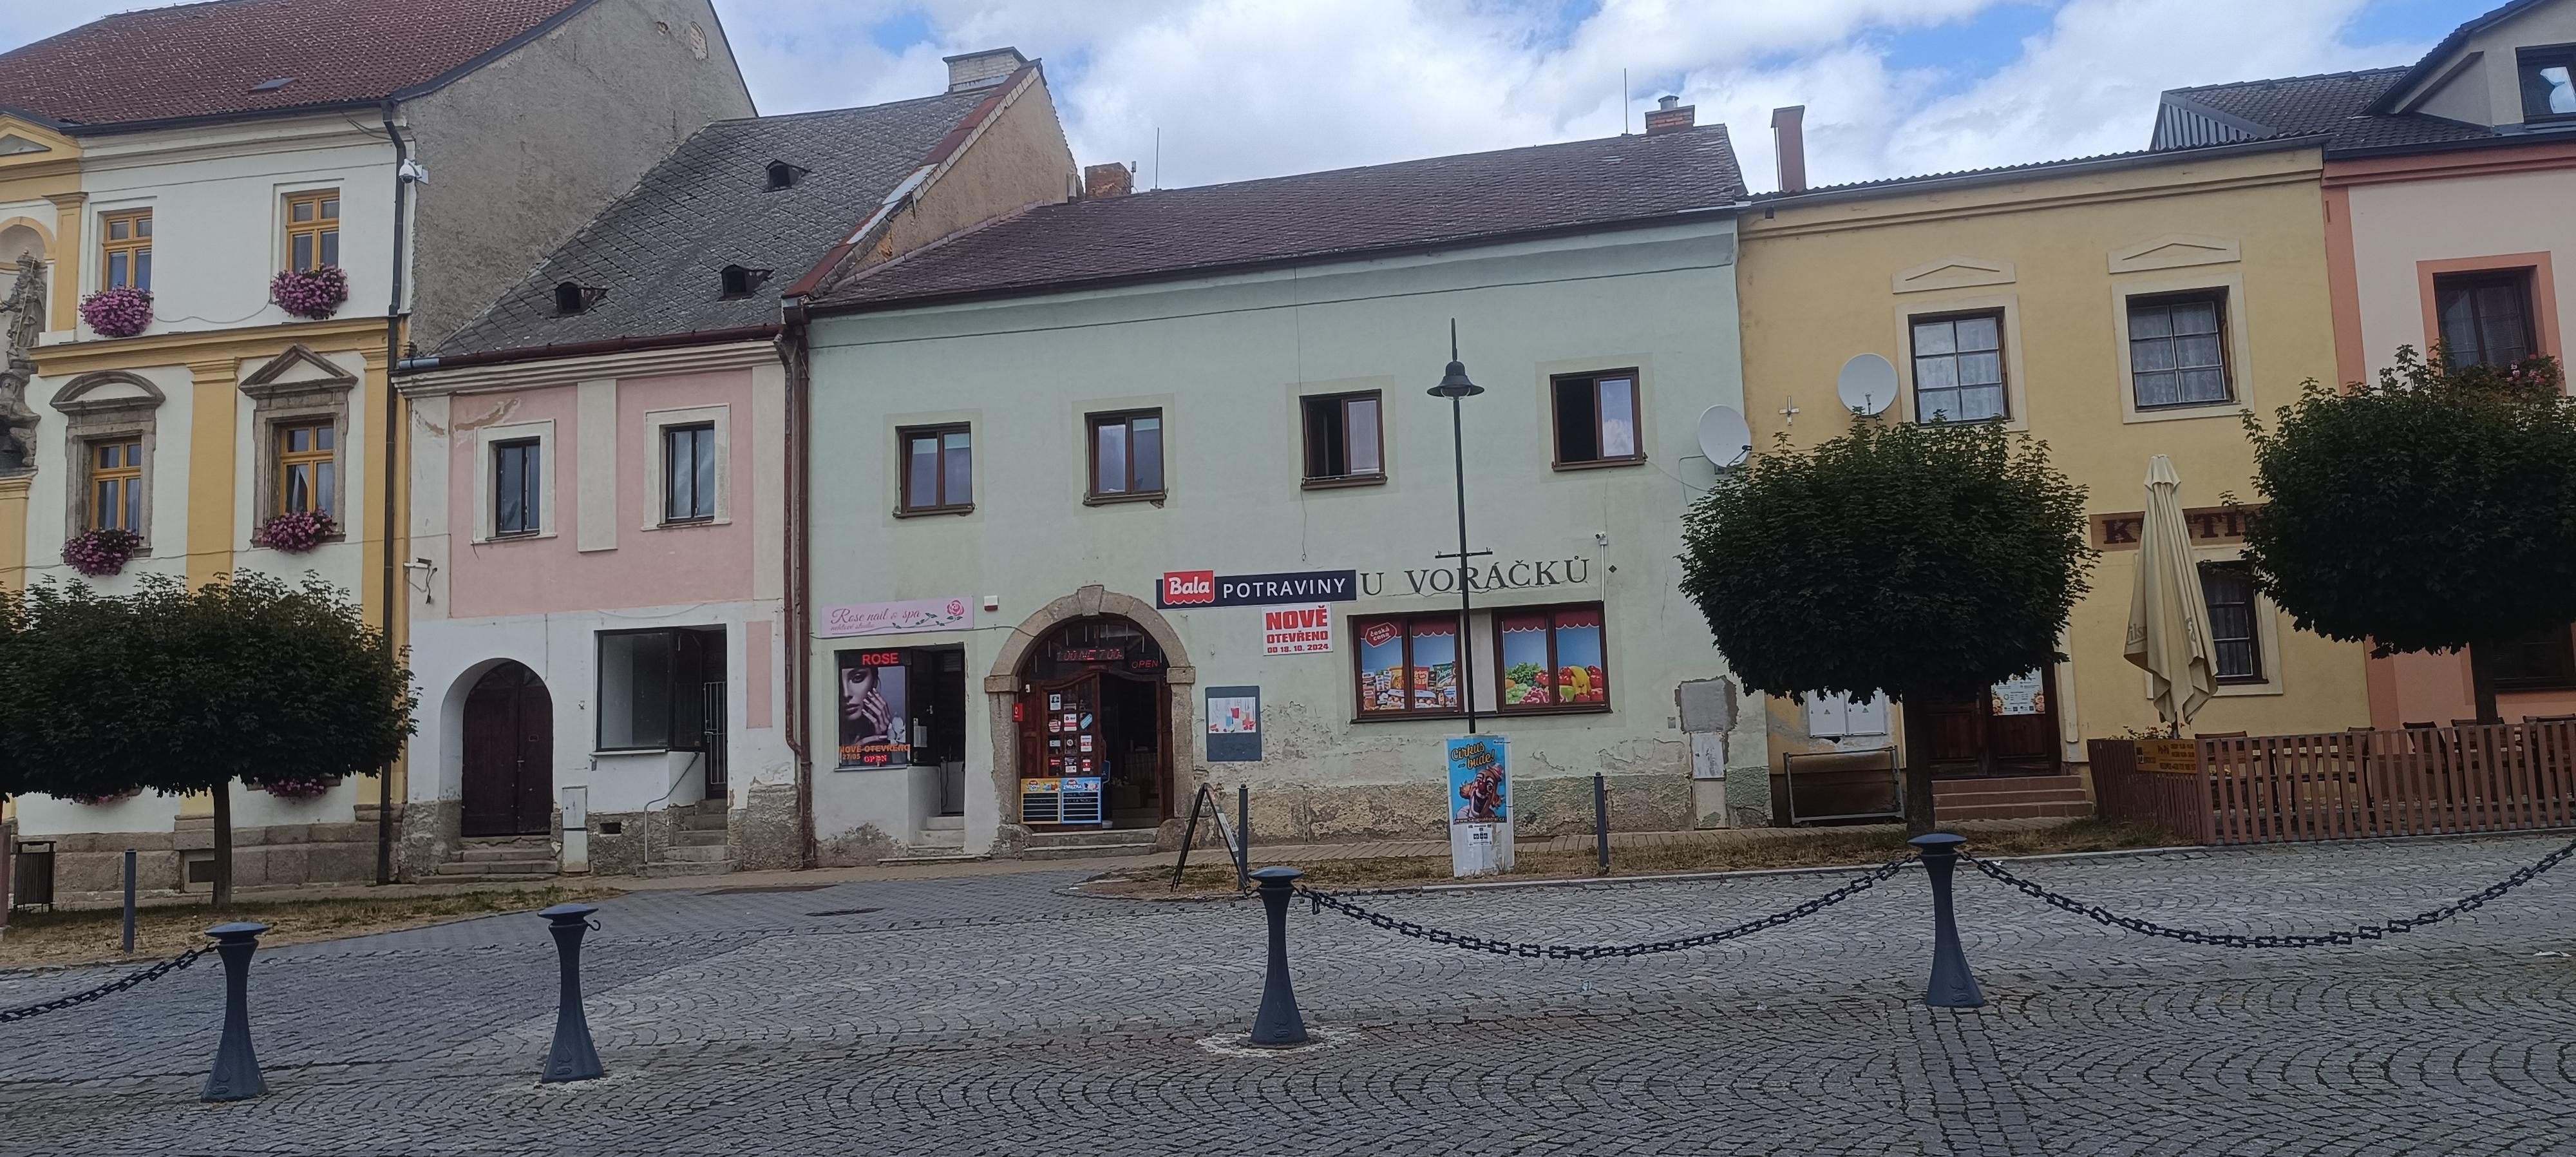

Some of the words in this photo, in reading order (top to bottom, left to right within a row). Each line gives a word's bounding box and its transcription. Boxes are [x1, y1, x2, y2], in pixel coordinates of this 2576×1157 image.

[1360, 572, 1385, 596] U
[1403, 555, 1590, 594] VORÁČKŮ
[1169, 576, 1210, 595] Bala
[1224, 578, 1346, 599] POTRAVINY
[831, 609, 864, 624] Rose
[867, 608, 889, 622] nail
[902, 609, 920, 623] spa
[1265, 605, 1328, 631] NOVĚ
[1267, 631, 1329, 644] OTEVŘENO
[1373, 633, 1390, 641] cena
[862, 653, 899, 665] ROSE
[1131, 660, 1159, 669] OPEN
[864, 754, 887, 763] OPEN
[1451, 741, 1486, 761] Cirkus
[1466, 749, 1495, 770] bude!
